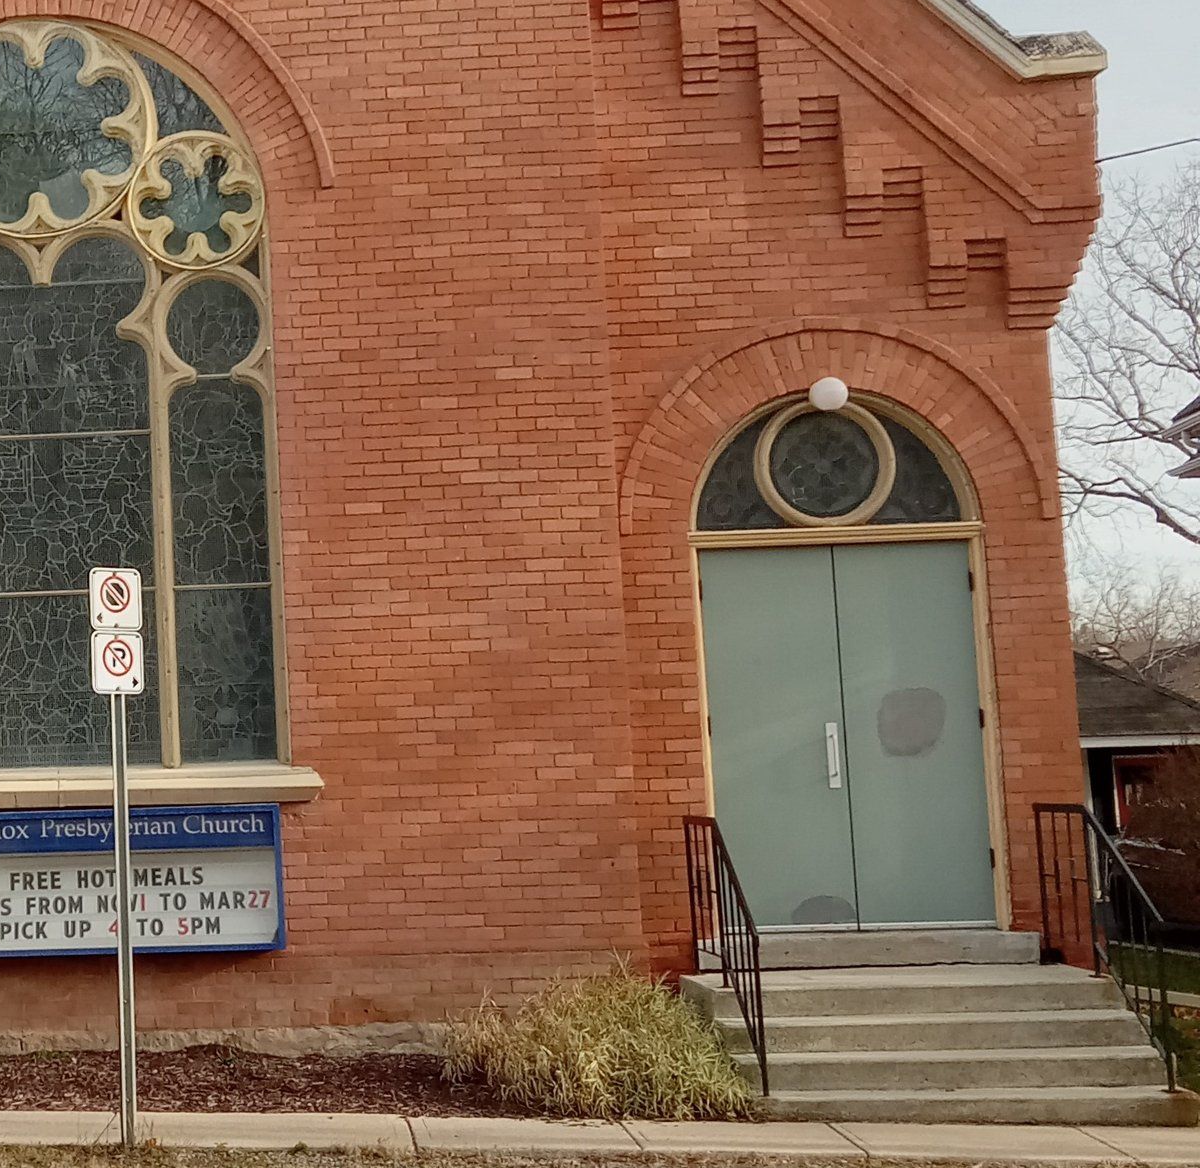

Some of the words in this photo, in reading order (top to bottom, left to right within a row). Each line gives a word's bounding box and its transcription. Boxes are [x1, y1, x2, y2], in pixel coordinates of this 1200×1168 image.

[40, 817, 177, 843] Presbyrian
[183, 814, 265, 834] Church
[9, 871, 62, 891] FREE
[77, 869, 117, 889] HOT
[133, 867, 204, 887] MEALS
[26, 895, 83, 915] FROM
[159, 893, 187, 911] TO
[200, 890, 271, 910] MAR27
[0, 921, 48, 940] PICK
[64, 920, 91, 938] UP
[136, 918, 164, 936] TO
[177, 916, 221, 935] 5PM
